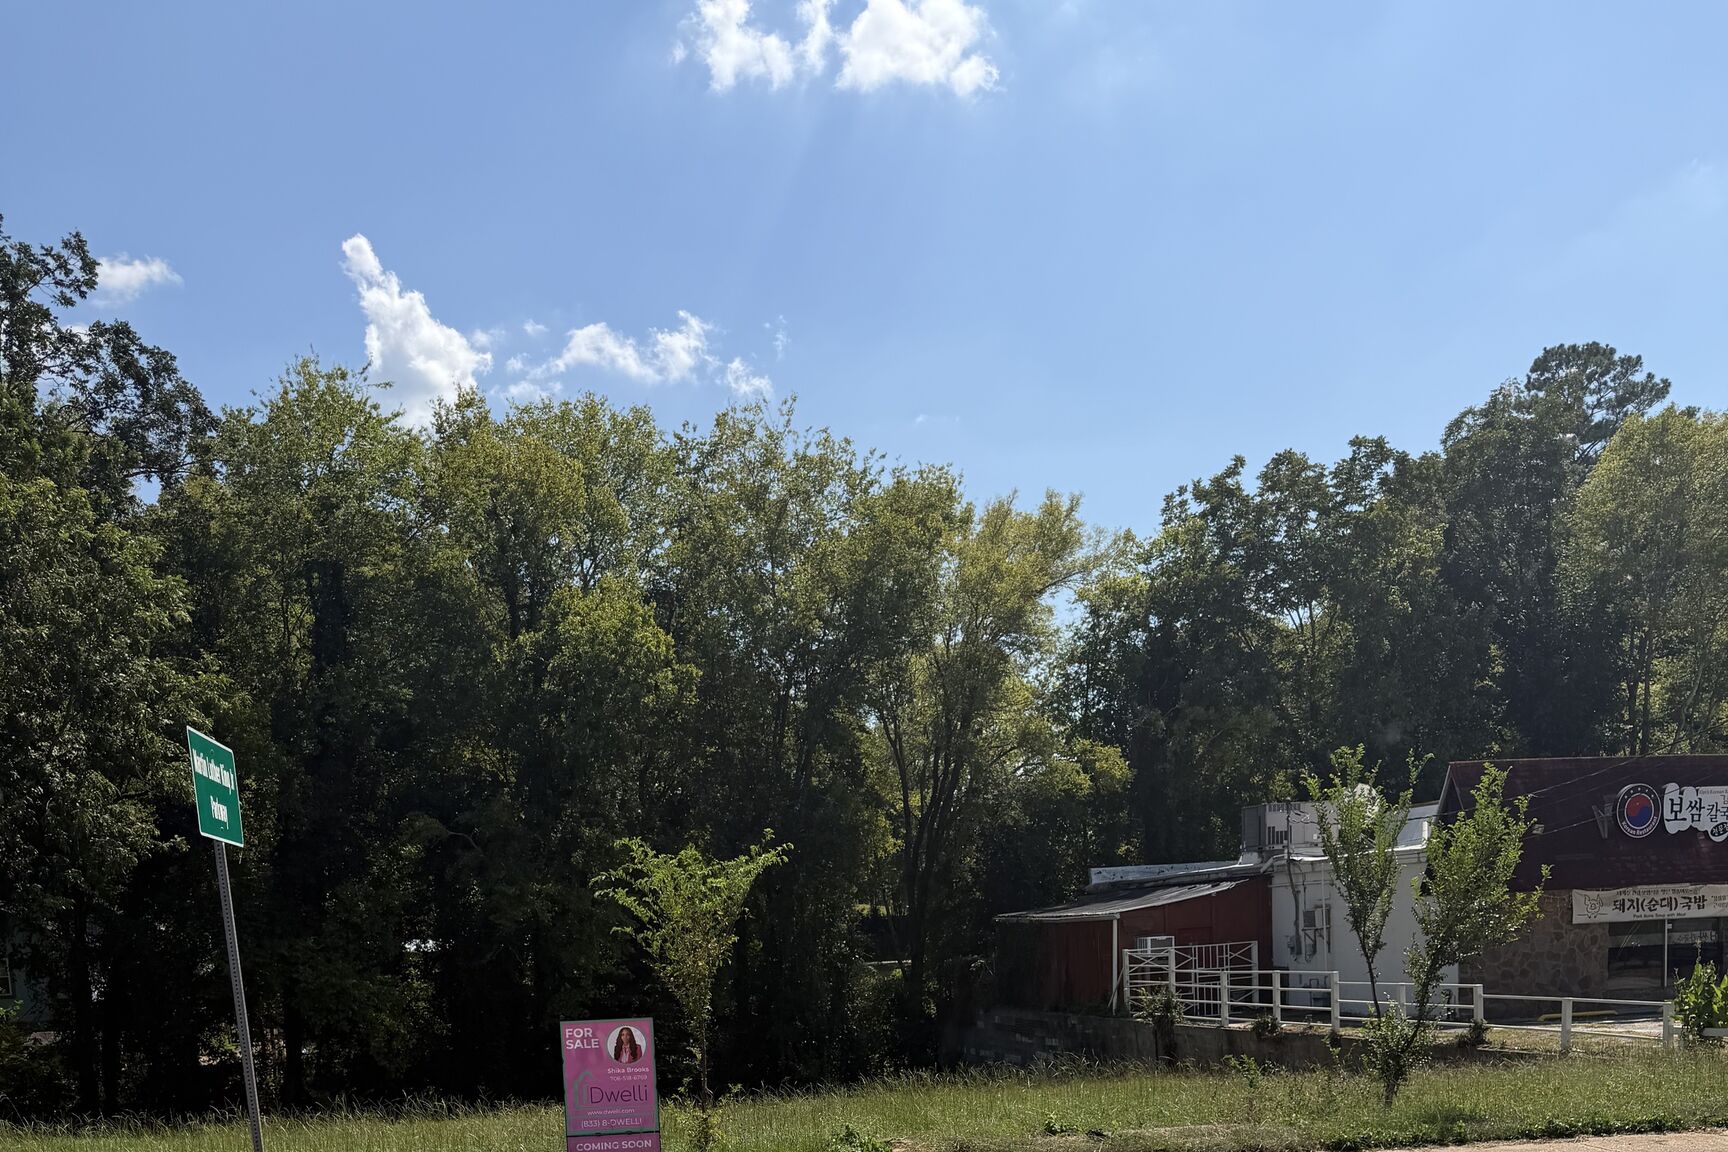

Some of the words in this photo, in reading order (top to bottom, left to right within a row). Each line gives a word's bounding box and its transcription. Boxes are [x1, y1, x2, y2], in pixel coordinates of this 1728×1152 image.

[1665, 797, 1705, 823] 보쌈
[1621, 821, 1636, 835] Korean
[1636, 816, 1658, 835] Restaurant
[565, 1028, 593, 1038] FOR
[566, 1038, 600, 1050] SALE
[590, 1084, 648, 1104] Dwelli
[576, 1141, 620, 1152] COMING
[621, 1139, 652, 1150] SOON
